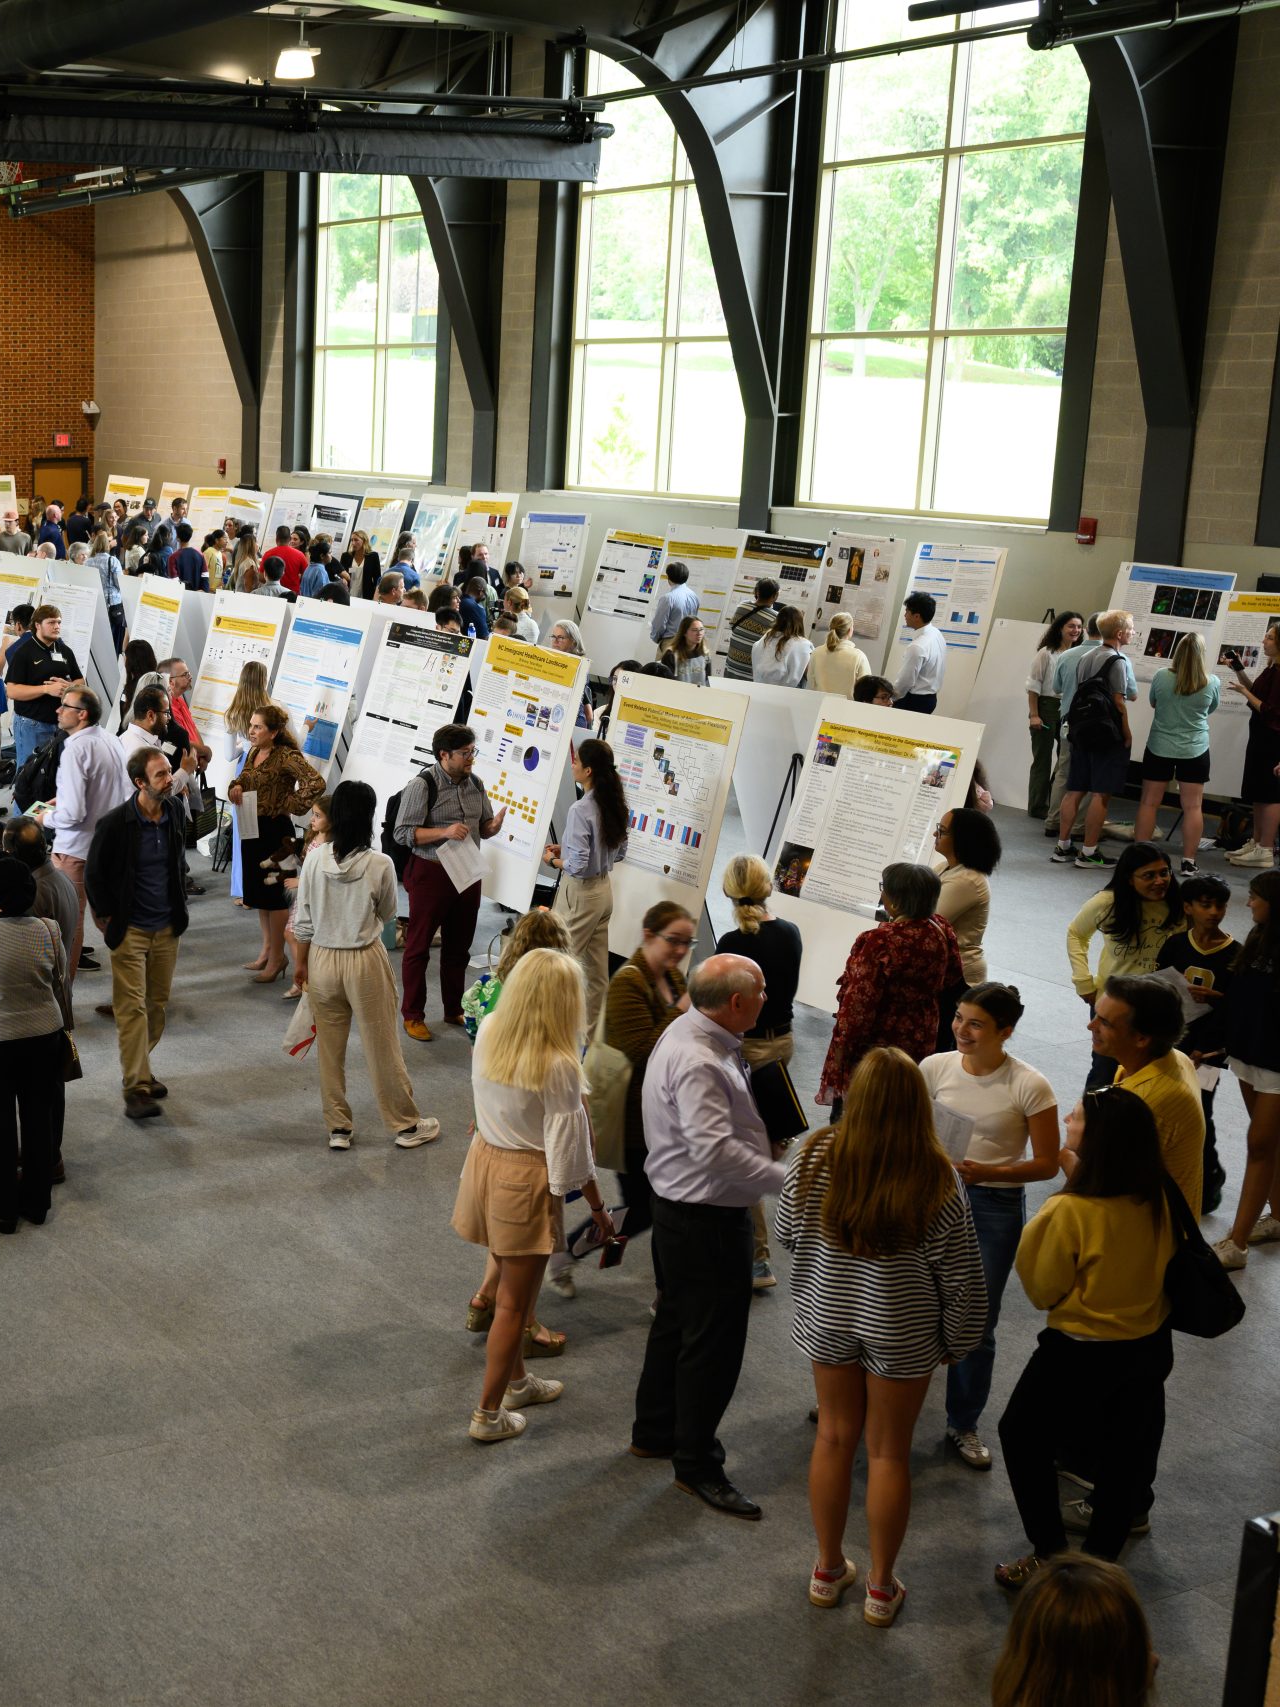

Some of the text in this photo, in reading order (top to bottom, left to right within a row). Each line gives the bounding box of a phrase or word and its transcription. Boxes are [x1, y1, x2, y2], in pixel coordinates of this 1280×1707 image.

[504, 646, 524, 658] Immigrant
[524, 651, 546, 663] Healthcare
[546, 657, 568, 669] Landscape
